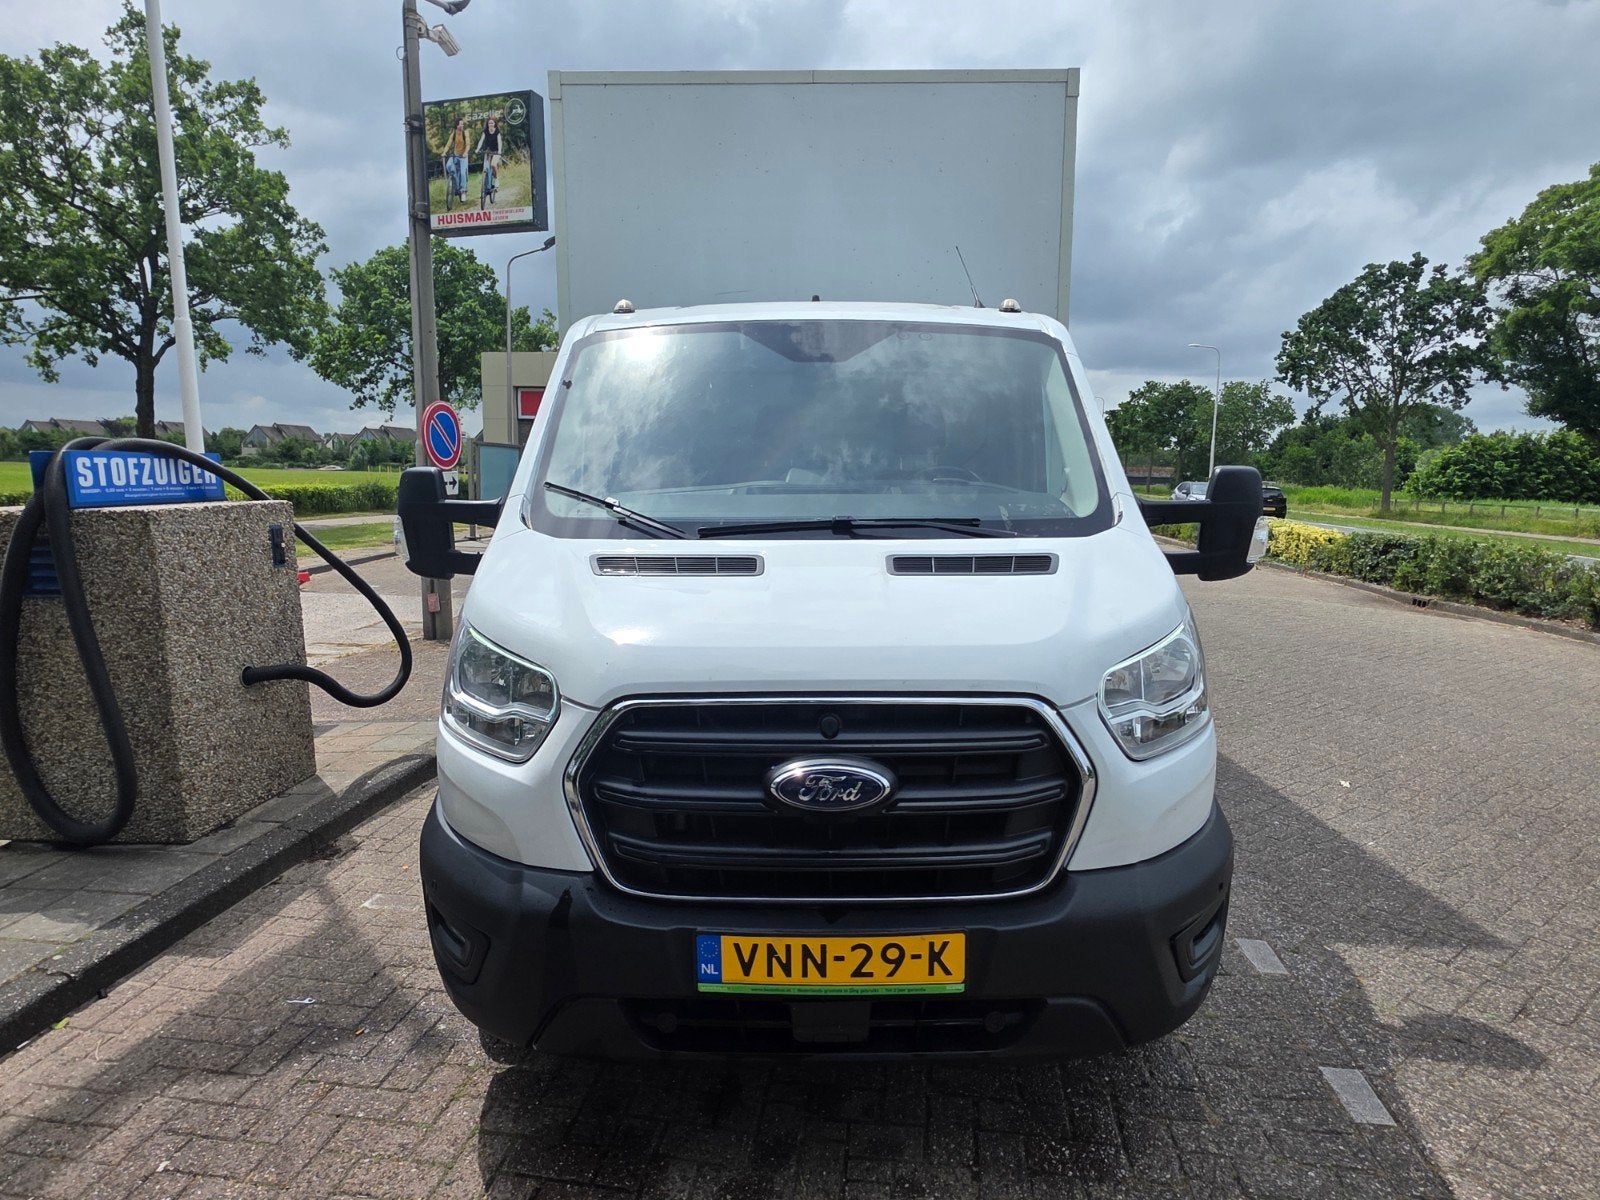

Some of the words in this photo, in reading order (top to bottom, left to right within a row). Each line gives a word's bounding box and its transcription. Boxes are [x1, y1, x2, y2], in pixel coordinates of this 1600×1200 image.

[437, 211, 492, 225] HUISMAN
[798, 774, 863, 802] Ford
[701, 963, 719, 975] NL
[733, 941, 953, 978] VNN-29-K
